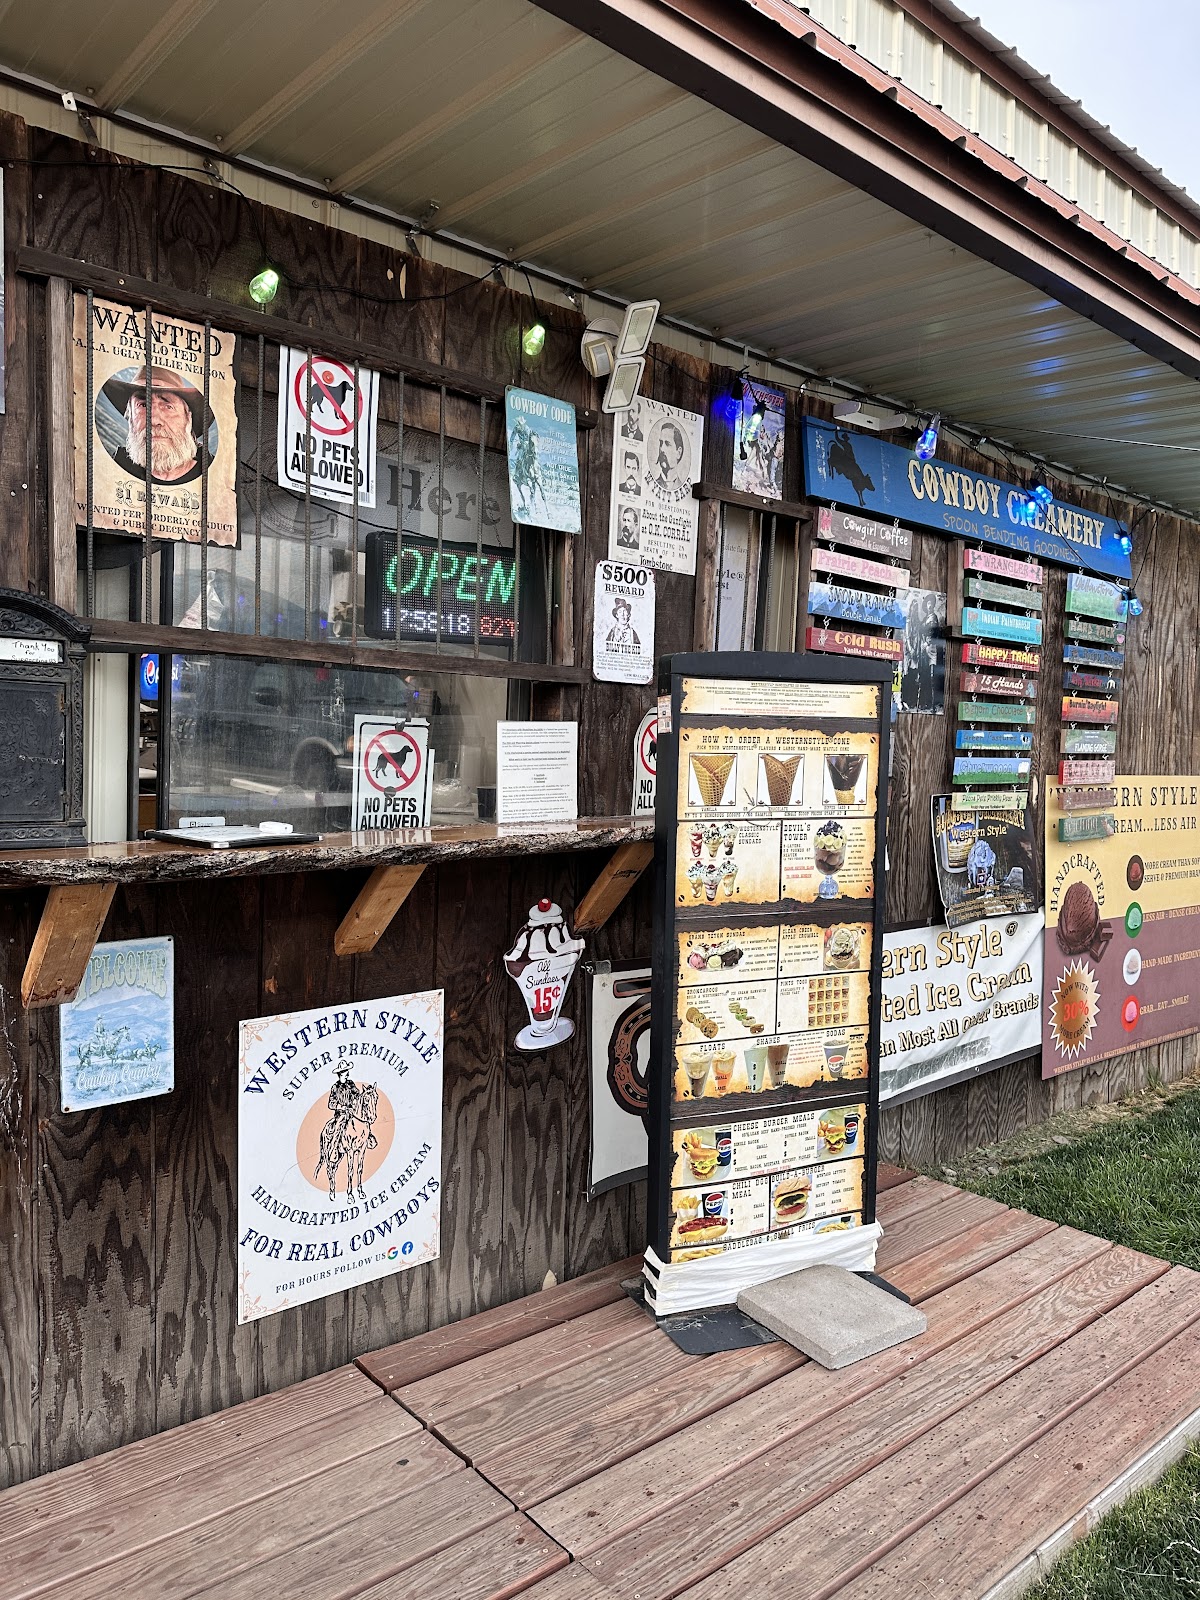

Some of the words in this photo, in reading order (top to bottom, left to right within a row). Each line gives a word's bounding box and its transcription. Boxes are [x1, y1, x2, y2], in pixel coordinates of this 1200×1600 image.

[91, 306, 222, 357] WANTED
[112, 346, 141, 361] UGLY
[119, 335, 168, 356] DIALO
[172, 346, 198, 363] TED
[510, 395, 549, 419] COWBOY
[551, 405, 572, 425] CODE
[645, 400, 698, 422] WANTED
[296, 432, 317, 455] NO
[322, 439, 360, 465] PETS
[291, 452, 364, 487] ALLOWED
[644, 471, 672, 503] WYATT
[907, 460, 1000, 519] COWBOY
[1005, 488, 1105, 550] CREAMERY
[123, 520, 158, 532] PUBLC
[158, 525, 202, 537] DECENCY
[642, 509, 658, 521] About
[659, 512, 668, 523] the
[669, 514, 692, 529] Gunfight
[641, 526, 647, 534] at
[648, 524, 662, 537] O.K.
[663, 526, 690, 542] CORRAL
[843, 517, 877, 540] Cowgirl
[880, 527, 908, 547] Coffee
[943, 512, 979, 537] SPOON
[983, 526, 1030, 553] BENDING
[1034, 537, 1081, 565] GOODNESS
[639, 555, 673, 571] Tombstone
[817, 551, 857, 571] Prairie
[861, 561, 892, 581] Peach
[983, 555, 1029, 577] WRANGLER
[386, 548, 516, 604] OPEN
[602, 563, 648, 586] $500
[605, 583, 645, 597] REWARD
[828, 586, 863, 609] SNOWY
[866, 594, 896, 613] RANGE
[841, 608, 863, 621] Double
[863, 613, 882, 624] Vanilla
[981, 612, 999, 625] INDIAN
[1001, 615, 1031, 631] PAINTBRUSH
[12, 641, 39, 650] Thank
[606, 642, 620, 653] BILLY
[632, 646, 641, 655] KID
[834, 631, 865, 647] Gold
[869, 637, 901, 652] Rush
[843, 646, 861, 656] Vanilla
[862, 649, 872, 657] with
[873, 651, 894, 660] Caramel
[978, 646, 1008, 662] HAPPY
[1010, 650, 1039, 666] TRAILS
[980, 675, 992, 685] 15
[992, 676, 1024, 690] Hands
[724, 736, 734, 744] TO
[738, 736, 761, 744] ORDER
[1074, 743, 1093, 752] FLAMING
[1094, 744, 1108, 752] GORGE
[960, 760, 1013, 775] Chuckwagon
[640, 779, 653, 794] NO
[1150, 786, 1198, 807] STYLE
[364, 797, 380, 814] NO
[384, 797, 417, 814] PETS
[360, 814, 420, 831] ALLOWED
[784, 822, 811, 831] DEVIL'S
[950, 828, 986, 839] Western
[986, 824, 1008, 837] Style
[1180, 817, 1197, 830] AIR
[784, 833, 808, 841] TOWER
[1144, 861, 1159, 871] MORE
[1159, 859, 1178, 870] CREAM
[1178, 858, 1191, 868] THAN
[1050, 853, 1106, 912] HANDCRAFTED
[1143, 873, 1160, 884] SERVE
[1165, 870, 1188, 881] PREMIUM
[1143, 912, 1156, 922] LESS
[1156, 911, 1165, 920] AIR
[1168, 909, 1185, 919] DENSE
[537, 960, 551, 973] All
[1141, 954, 1172, 969] HAND-MADE
[525, 972, 561, 989] Sundaes
[925, 982, 960, 1011] Ice
[966, 961, 1032, 1002] Cream
[532, 986, 561, 1015] 15¢
[1061, 985, 1074, 1001] NOW
[1075, 982, 1089, 995] WITH
[1064, 1000, 1089, 1022] 30%
[898, 1022, 934, 1052] Most
[936, 1017, 959, 1040] All
[961, 1009, 991, 1031] Other
[992, 993, 1039, 1018] Brands
[1059, 1024, 1073, 1039] MORE
[1073, 1017, 1091, 1039] CREAM
[826, 1029, 846, 1038] SODAS
[243, 1009, 369, 1097] WESTERN
[700, 1043, 726, 1052] FLOATS
[756, 1037, 781, 1046] SHAKES
[1104, 1047, 1127, 1060] REGISTERED
[1127, 1044, 1137, 1053] MARK
[1140, 1038, 1158, 1049] PROPERTY
[1162, 1032, 1176, 1042] COWBOY
[1176, 1028, 1194, 1039] CREAMERY
[77, 1069, 118, 1091] Cowboy
[121, 1062, 162, 1083] Country
[282, 1051, 334, 1101] SUPER
[338, 1042, 410, 1078] PREMIUM
[733, 1122, 759, 1132] CHEESE
[763, 1117, 788, 1127] BURGER
[792, 1112, 815, 1122] MEALS
[250, 1184, 361, 1226] HANDCRAFTED
[364, 1192, 388, 1214] ICE
[390, 1141, 433, 1195] CREAM
[732, 1181, 751, 1190] CHILI
[755, 1177, 768, 1187] DOG
[772, 1166, 825, 1183] BUILD-A-BURGER
[732, 1191, 752, 1200] MEAL
[239, 1227, 283, 1260] FOR
[286, 1240, 343, 1262] REAL
[349, 1176, 440, 1252] COWBOYS
[723, 1236, 763, 1251] SADDLEBAG
[798, 1222, 816, 1233] FRIES
[275, 1284, 296, 1294] FOR
[298, 1270, 332, 1287] HOURS
[334, 1256, 372, 1275] FOLLOW
[374, 1251, 387, 1262] US
